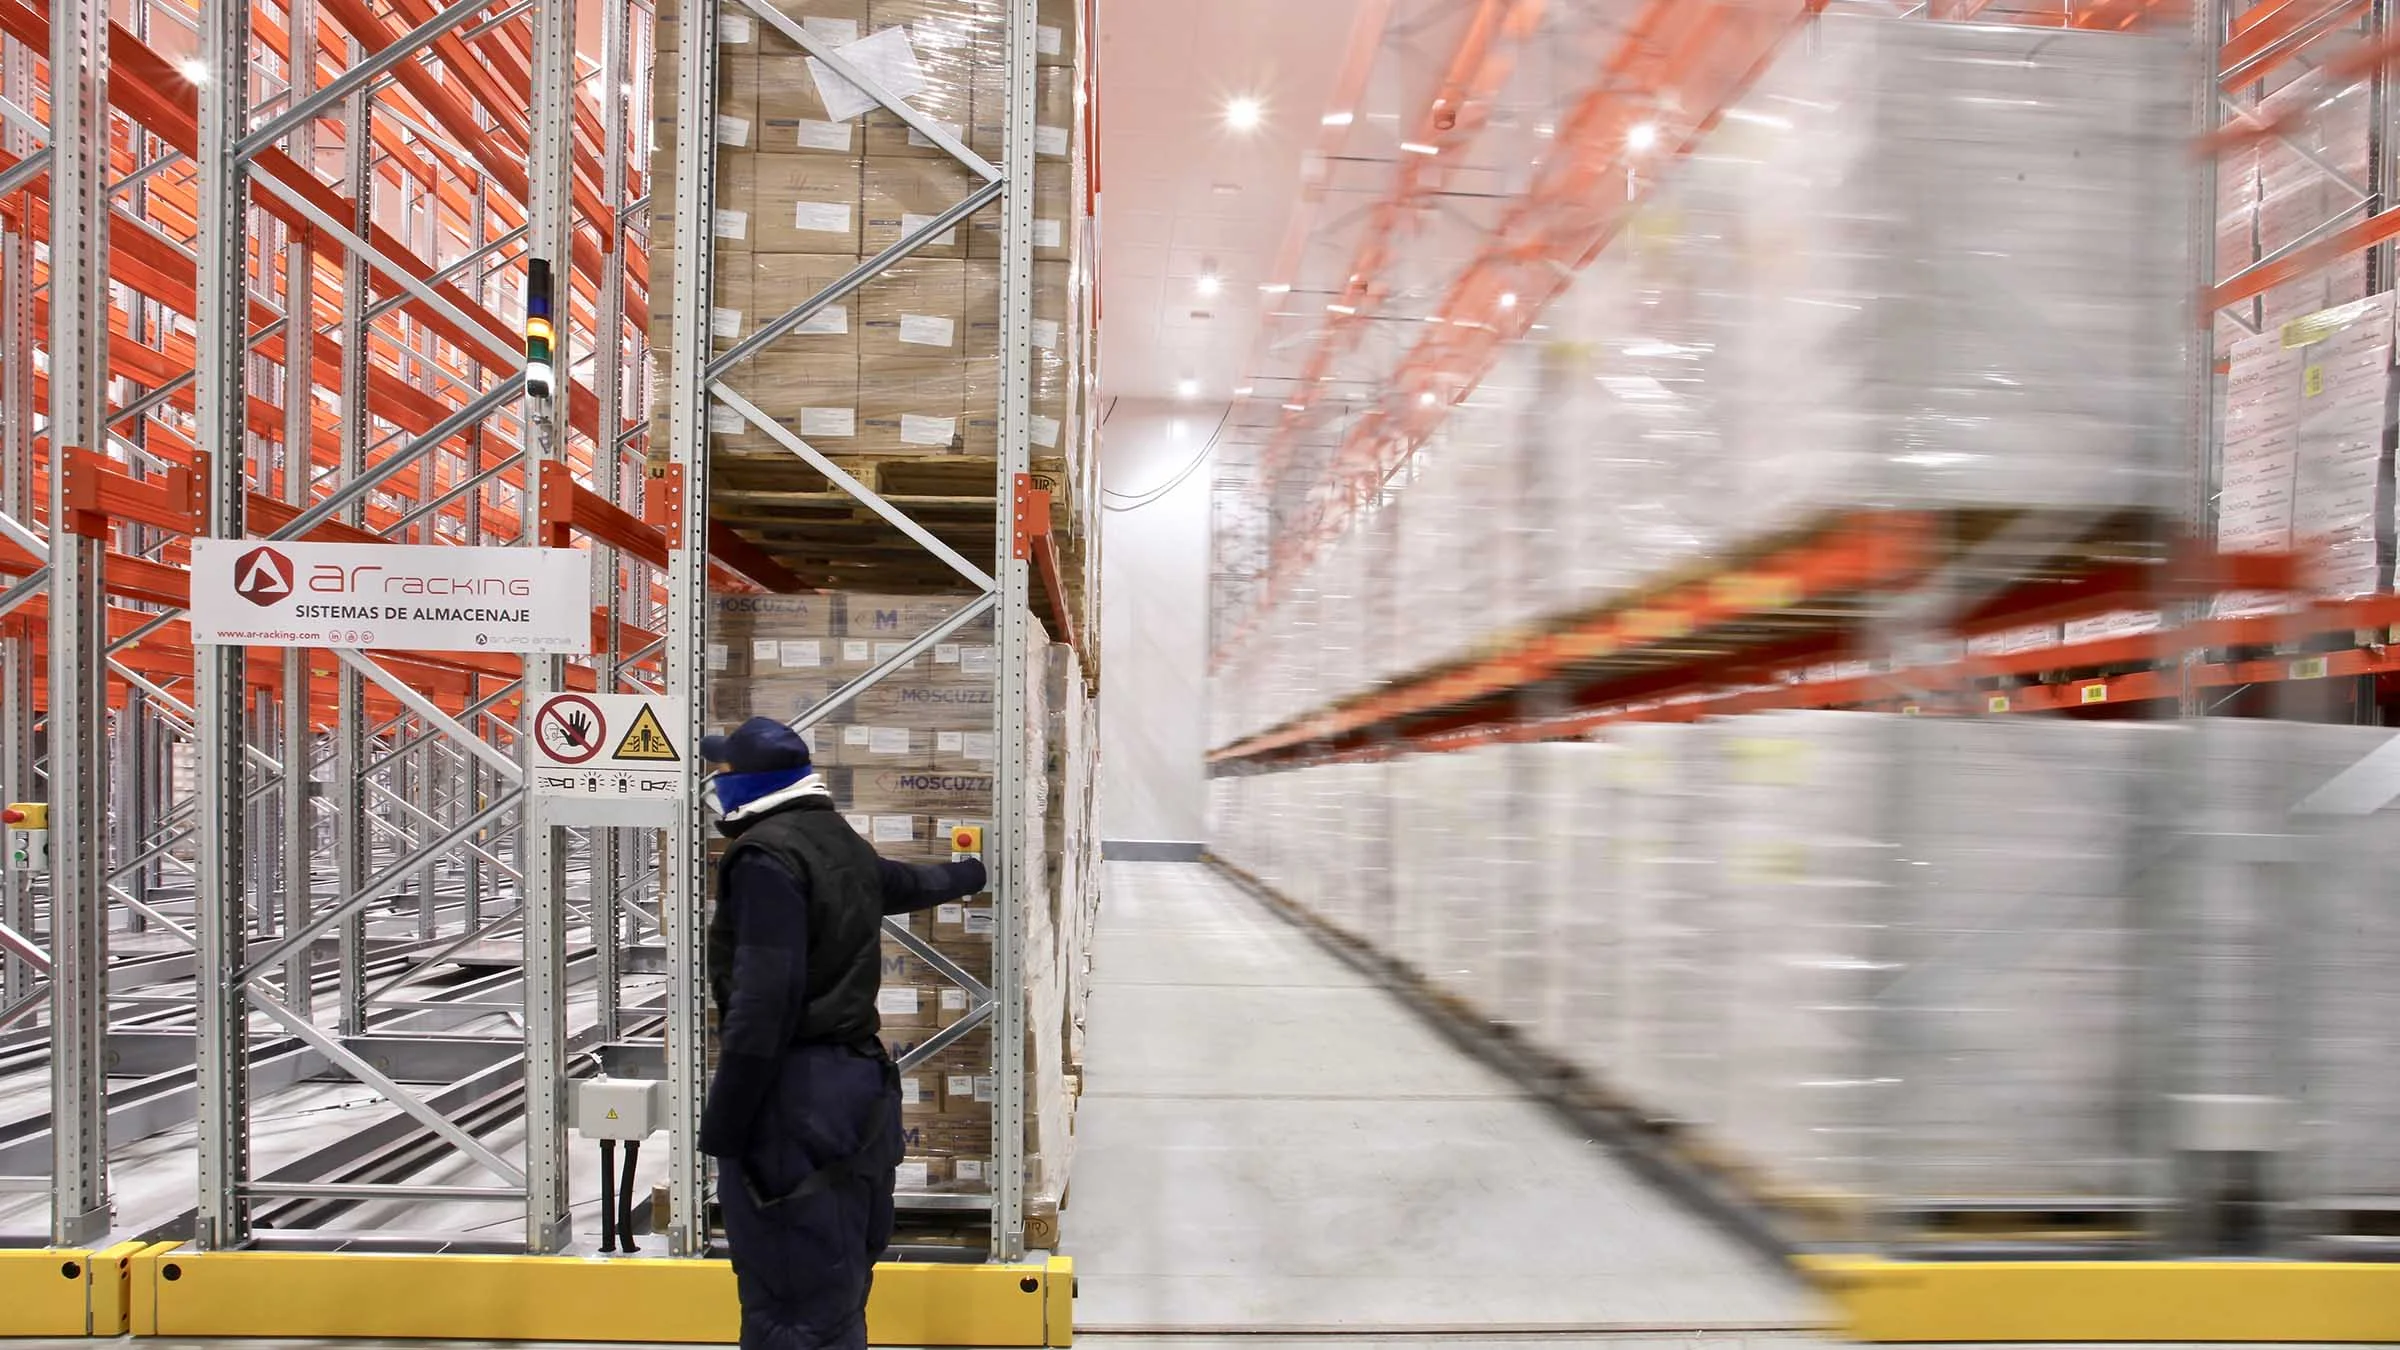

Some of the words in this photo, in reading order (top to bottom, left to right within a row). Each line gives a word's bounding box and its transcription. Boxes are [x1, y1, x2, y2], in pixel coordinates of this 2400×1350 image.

[295, 604, 379, 620] SISTEMAS
[384, 607, 408, 621] DE
[412, 607, 531, 623] ALMACENAJE
[216, 629, 321, 642] www.ar-racking.com
